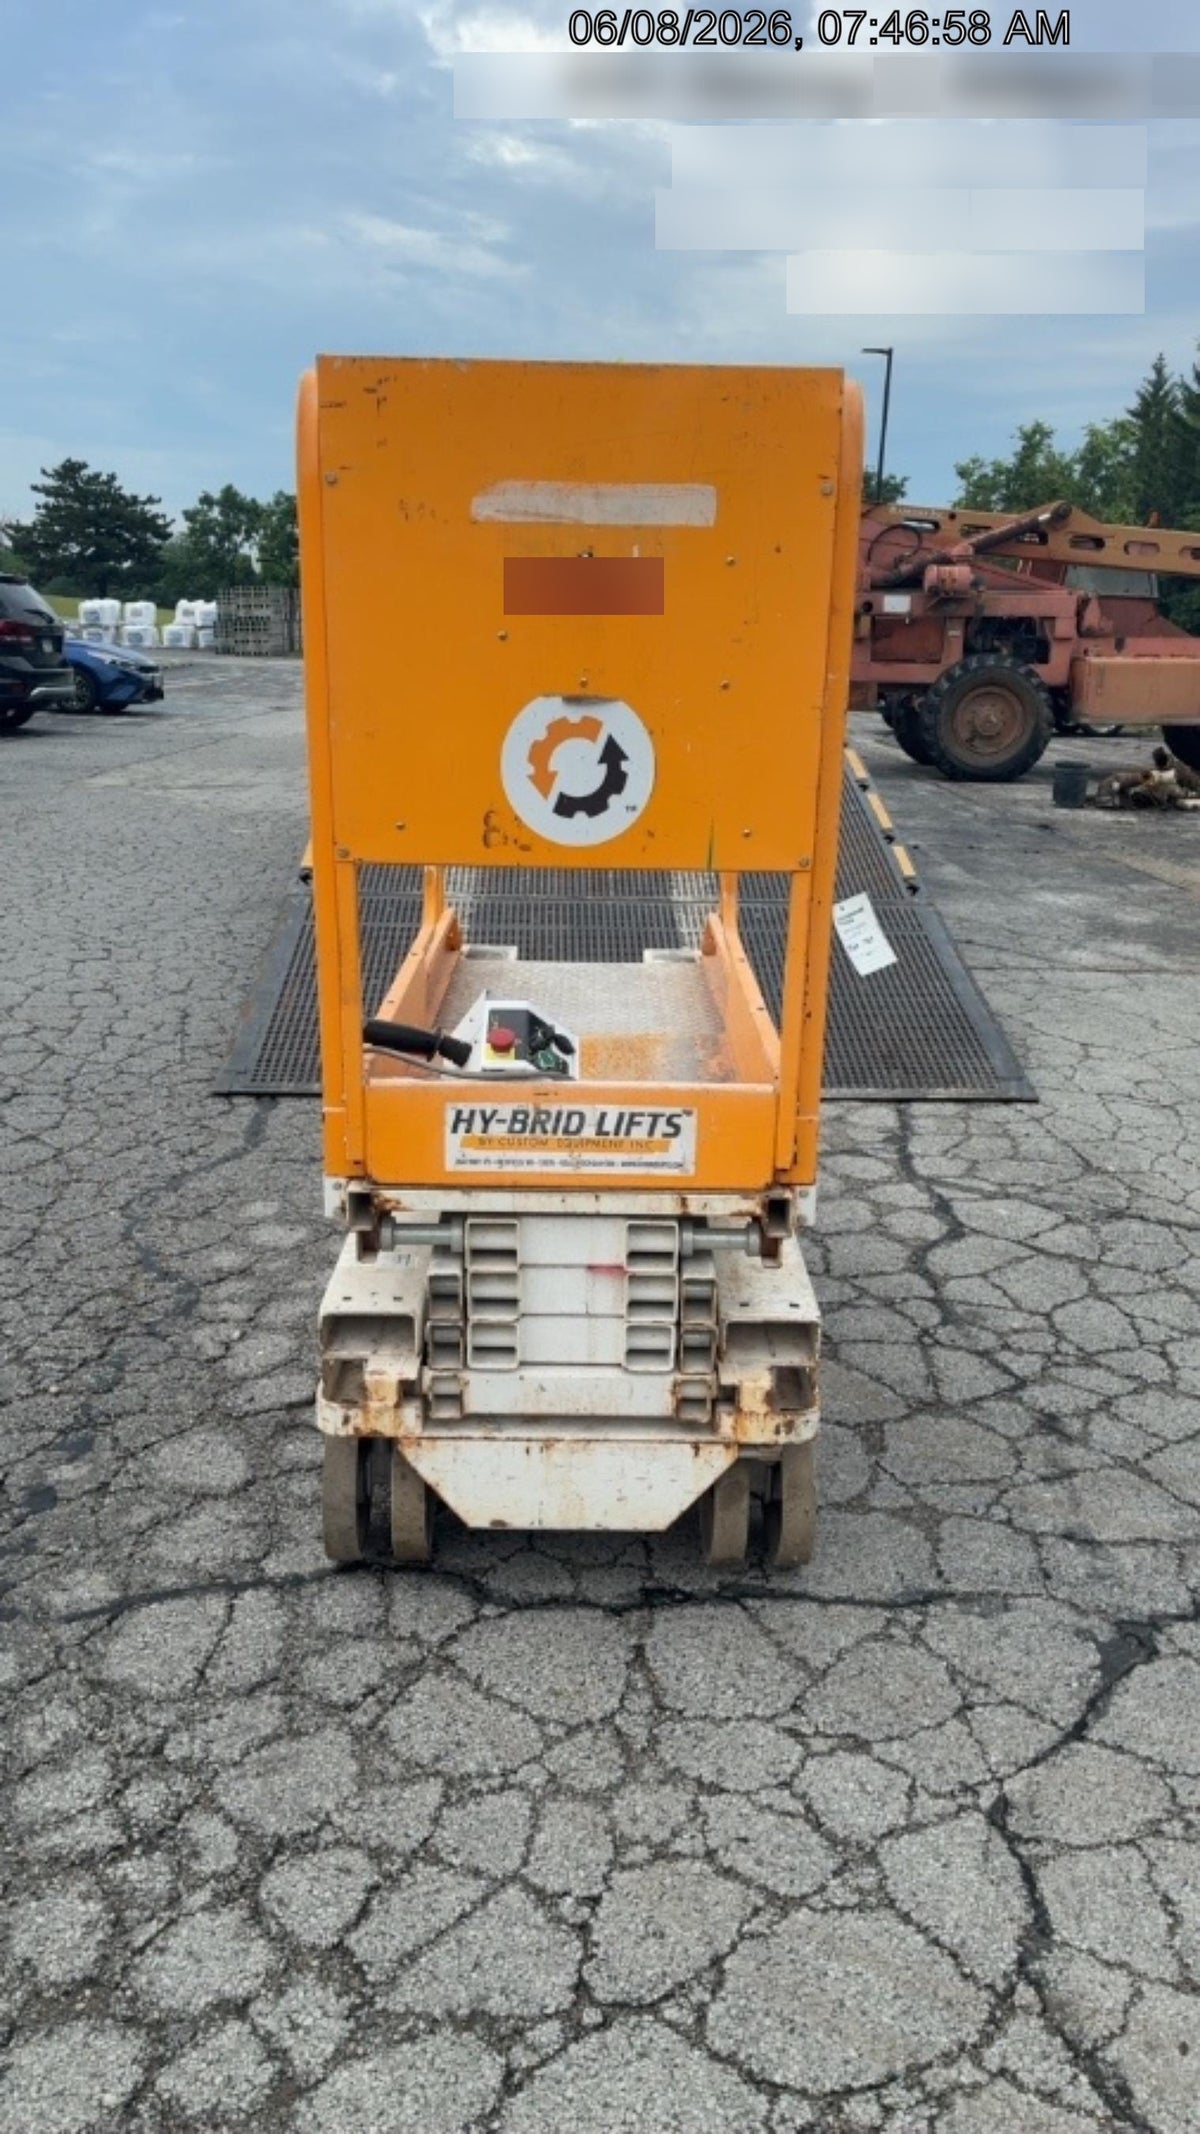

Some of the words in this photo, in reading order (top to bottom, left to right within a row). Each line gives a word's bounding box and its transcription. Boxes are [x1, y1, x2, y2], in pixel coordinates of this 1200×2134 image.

[451, 1108, 586, 1136] HY-BRID
[595, 1111, 682, 1138] LIFTS
[498, 1137, 550, 1148] CUSTOM
[556, 1138, 625, 1150] EQUIPMENT
